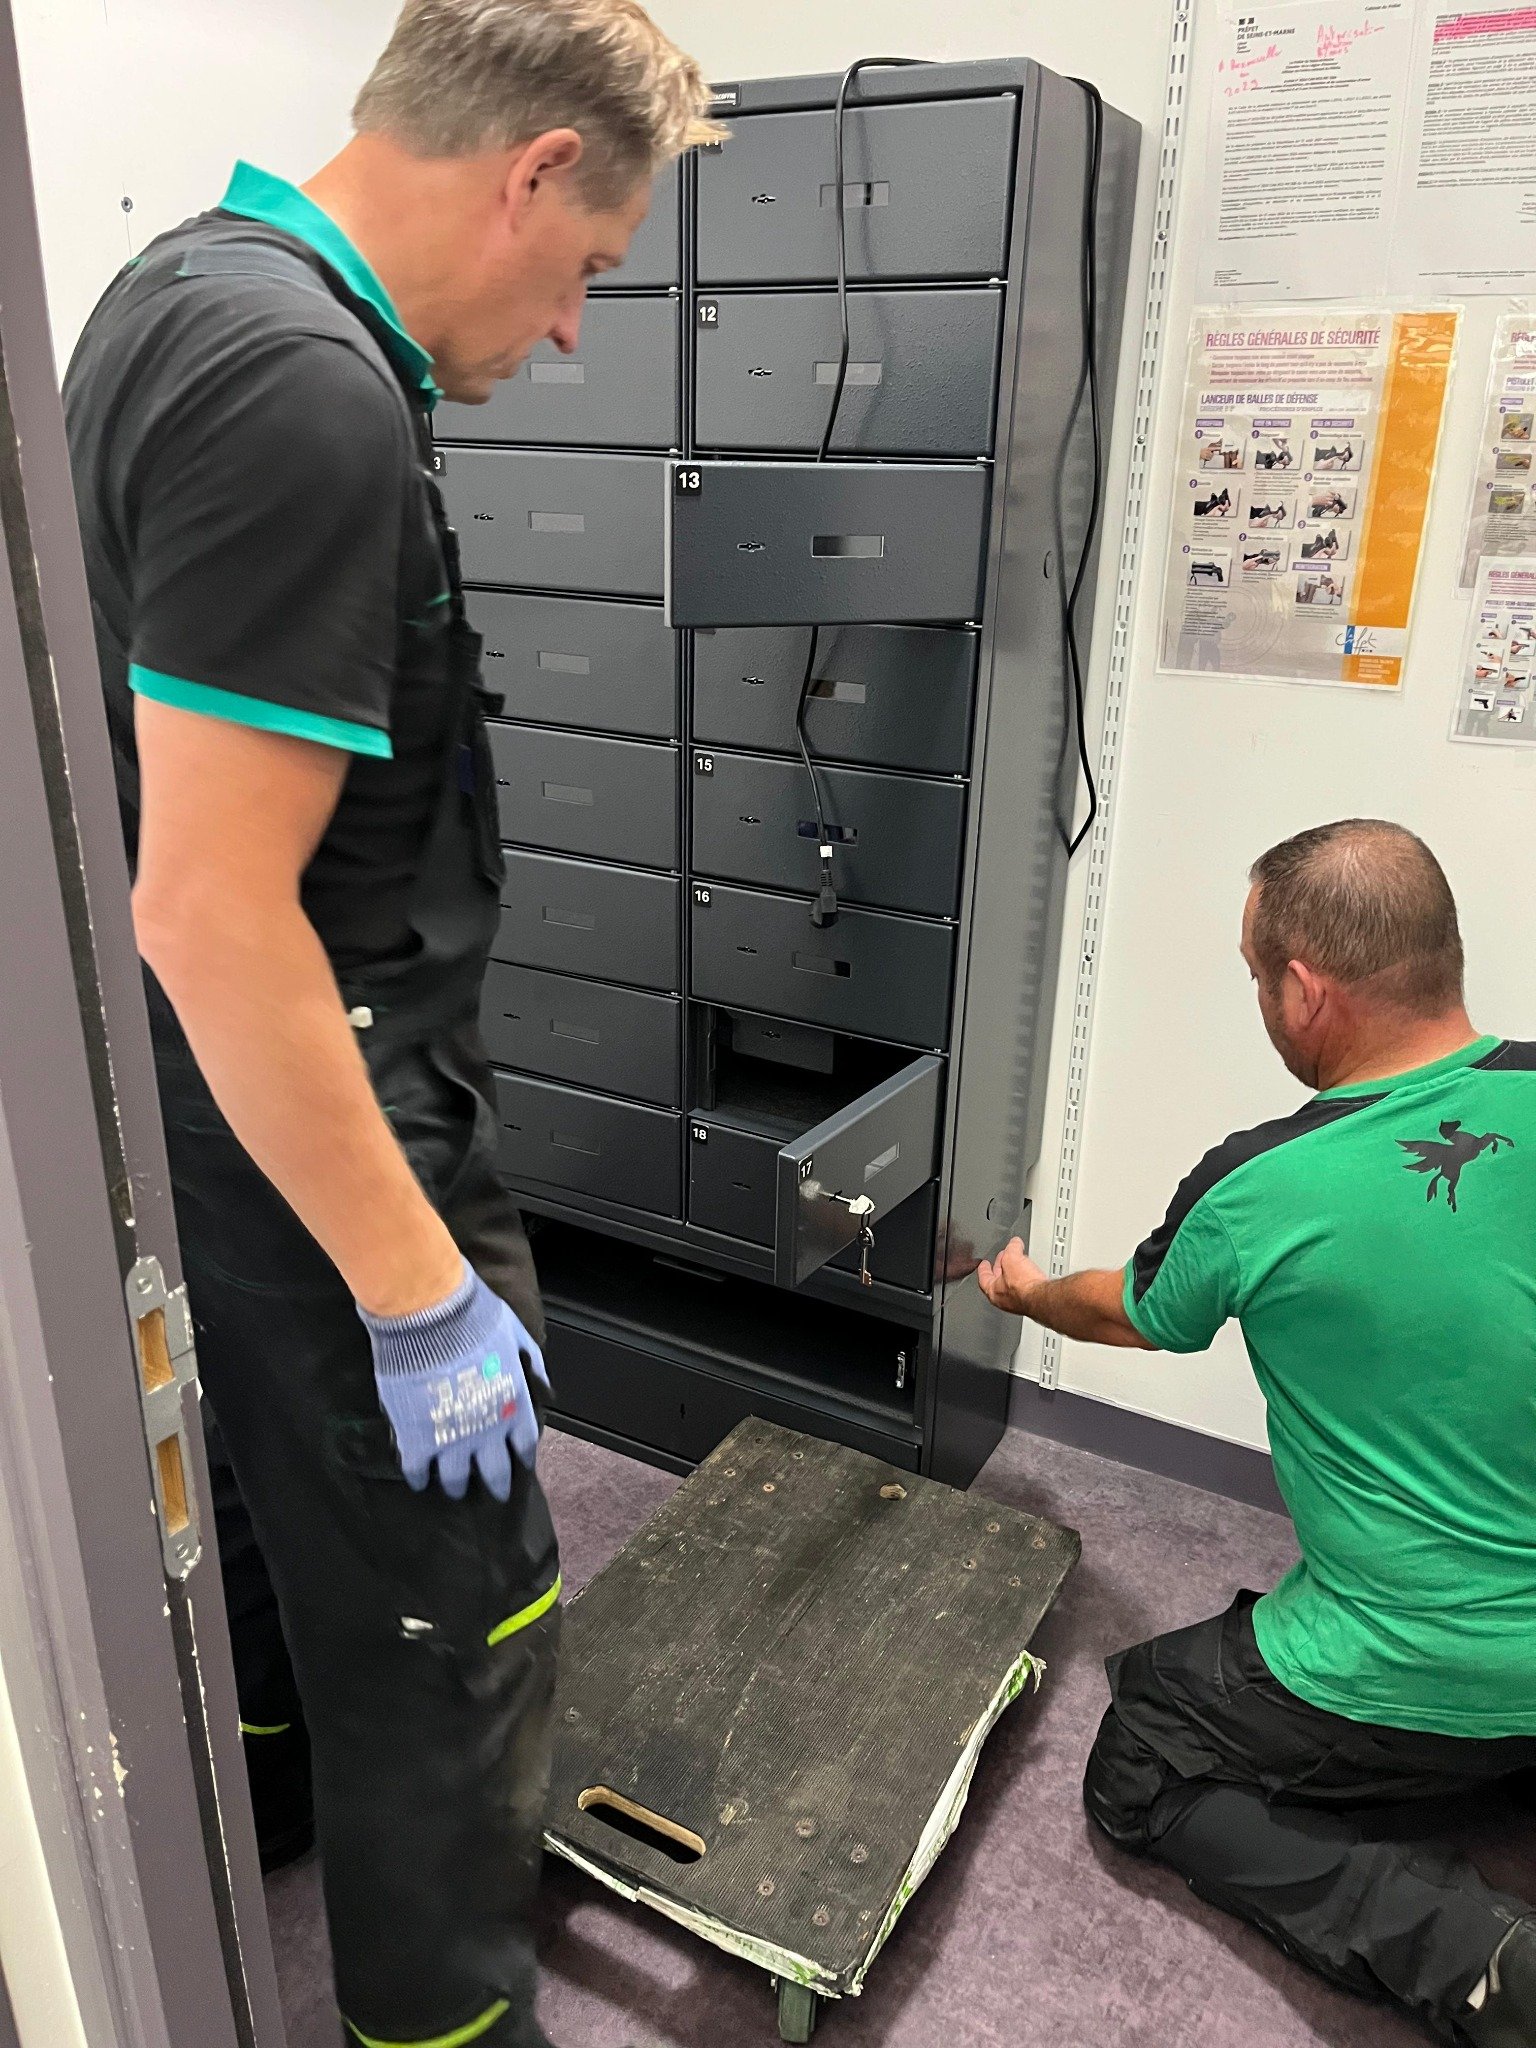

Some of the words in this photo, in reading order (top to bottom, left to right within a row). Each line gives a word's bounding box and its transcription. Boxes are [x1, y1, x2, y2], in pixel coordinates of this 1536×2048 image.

[699, 306, 717, 322] 12
[1206, 330, 1245, 347] RÈGLES
[1247, 329, 1307, 346] GÉNÉRALES
[1310, 330, 1325, 345] DE
[1327, 327, 1381, 345] SÉCURITÉ
[1201, 394, 1235, 405] LANCEUR
[1235, 393, 1245, 404] DE
[1246, 393, 1274, 404] BALLES
[1275, 393, 1285, 404] DE
[1286, 391, 1319, 404] DÉFENSE
[433, 456, 441, 470] 3
[678, 471, 700, 489] 13
[697, 757, 713, 771] 15
[694, 889, 710, 903] 16
[692, 1127, 707, 1140] 18
[800, 1160, 813, 1178] 17
